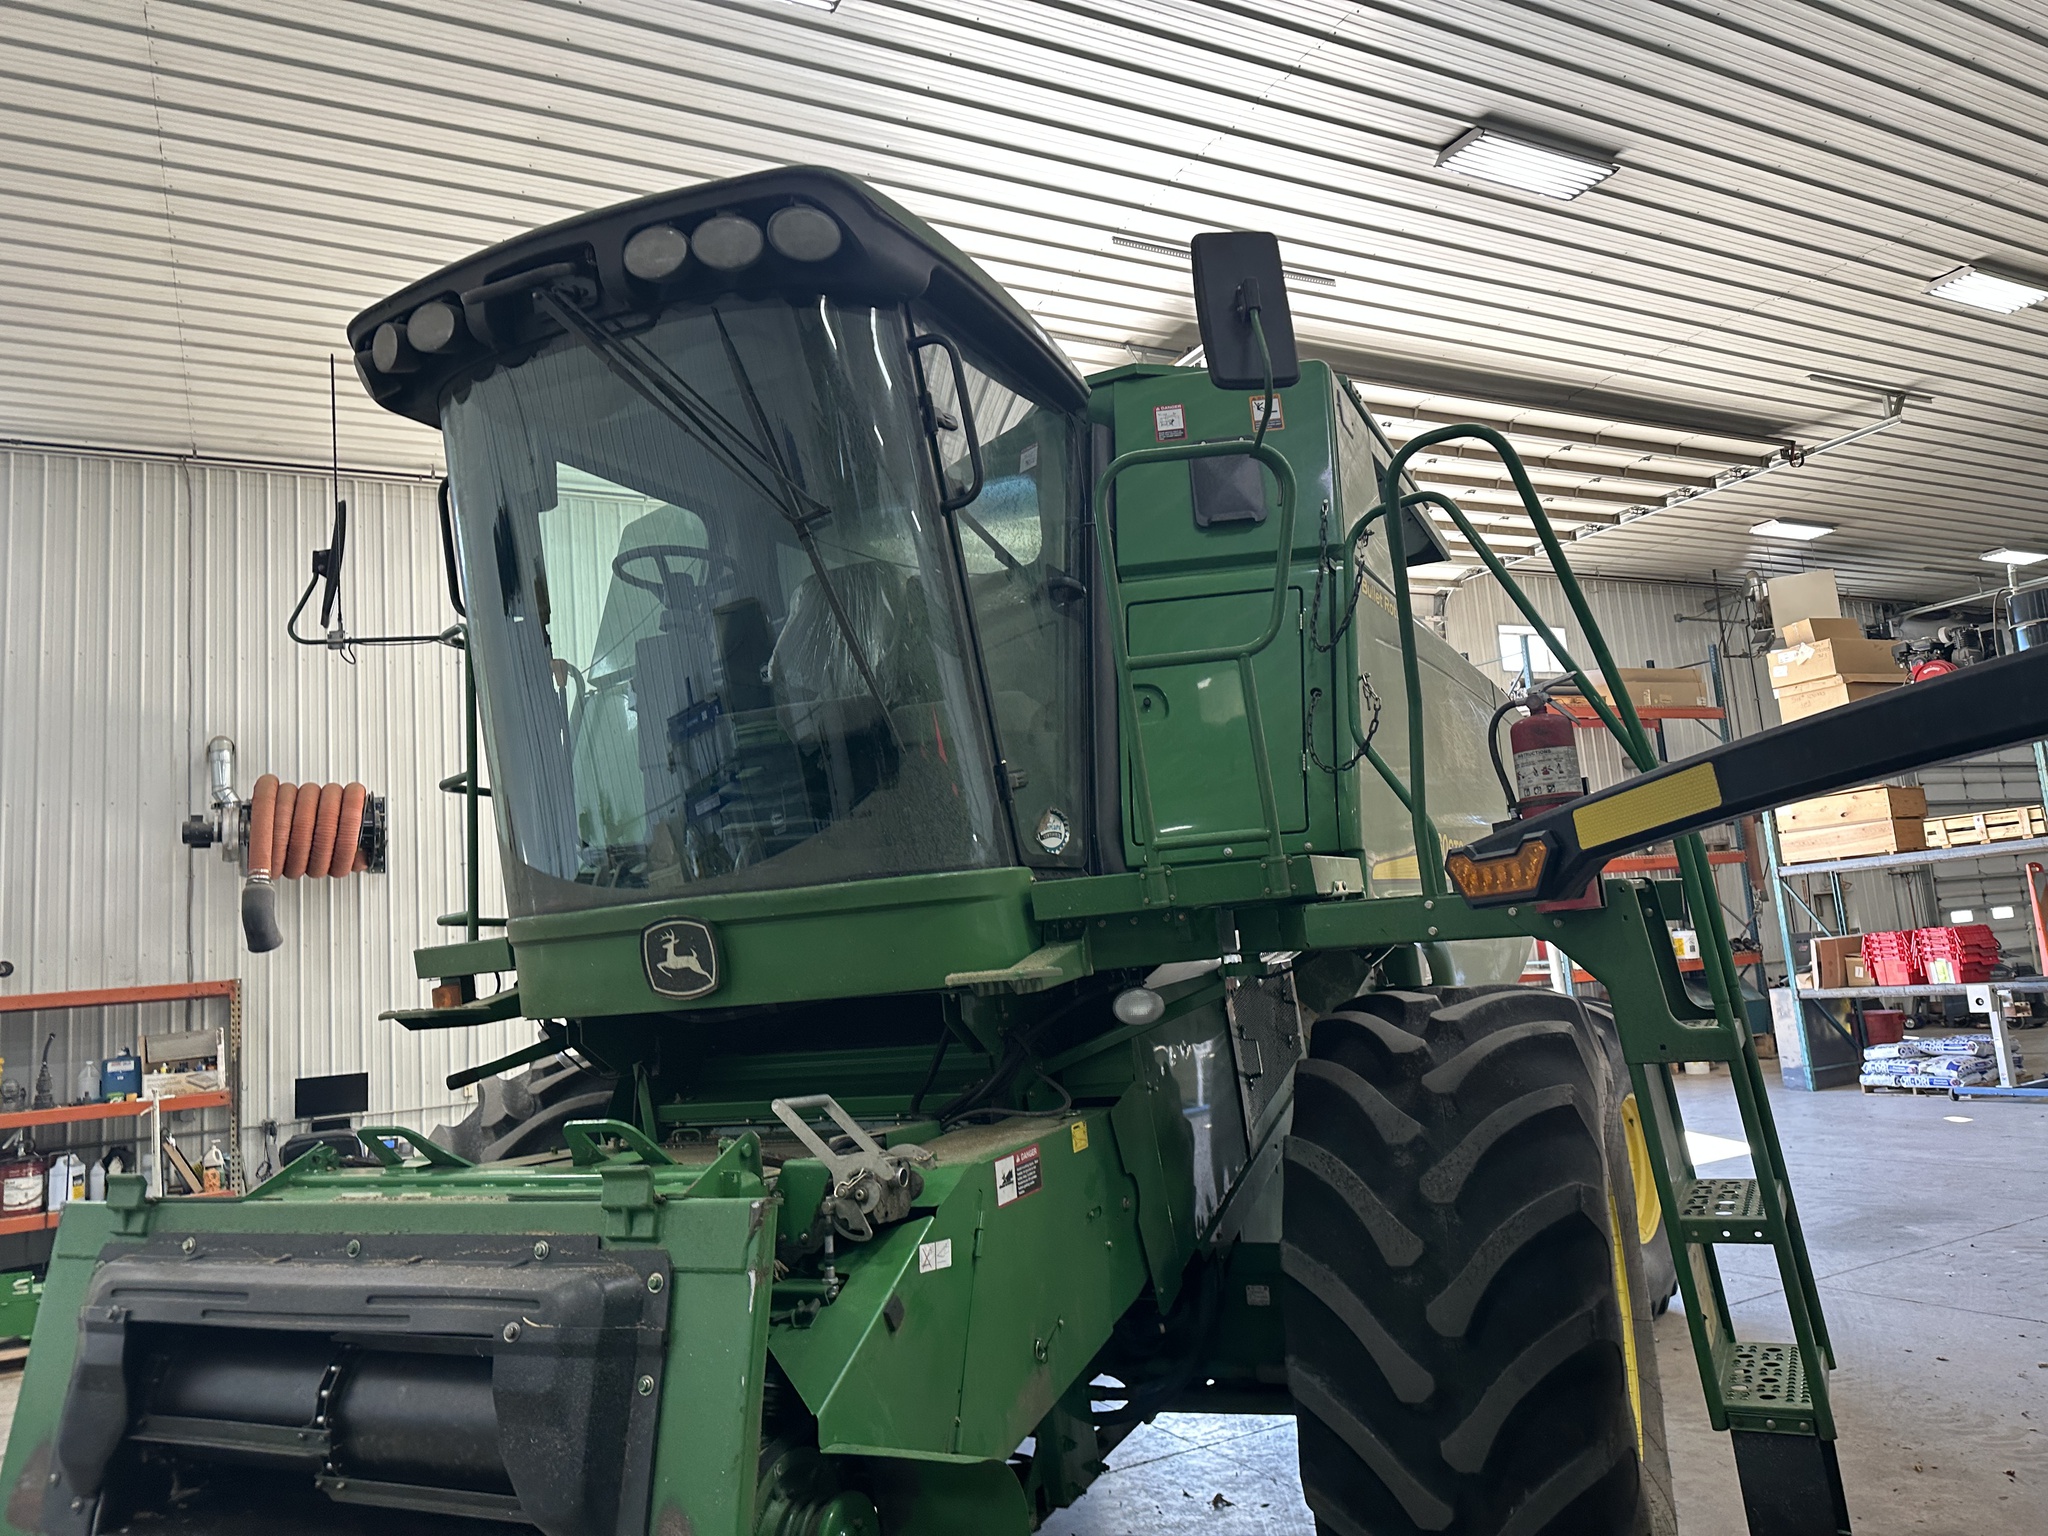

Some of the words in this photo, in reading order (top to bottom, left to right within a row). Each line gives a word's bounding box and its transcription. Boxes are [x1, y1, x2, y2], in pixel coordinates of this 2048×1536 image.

[1361, 577, 1384, 608] Bullet
[1384, 594, 1398, 620] Rot
[1020, 1147, 1038, 1161] DANGER
